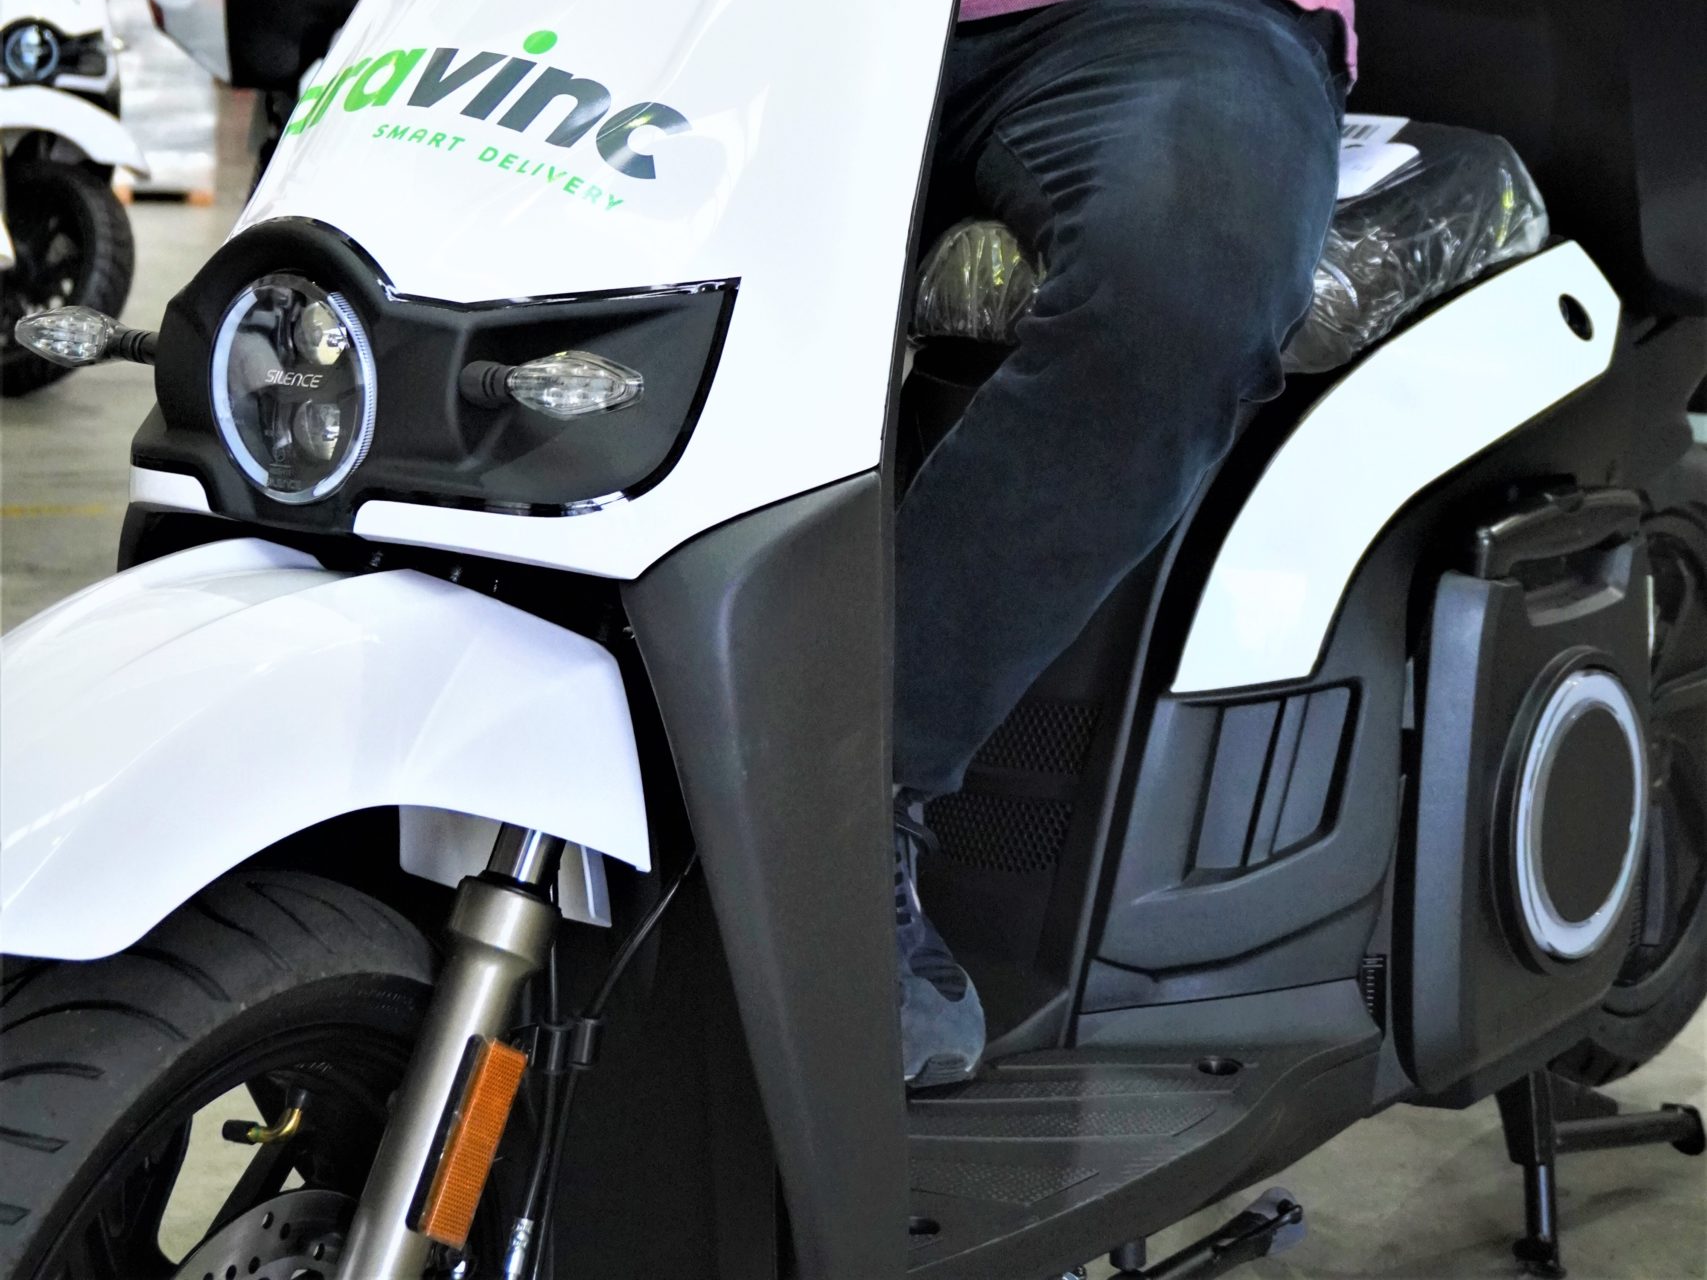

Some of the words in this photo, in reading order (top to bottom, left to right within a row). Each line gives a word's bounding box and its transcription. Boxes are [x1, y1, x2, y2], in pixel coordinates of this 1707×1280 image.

[372, 123, 465, 151] SMART
[477, 146, 624, 210] DELIVERY
[264, 369, 323, 388] SILENCE
